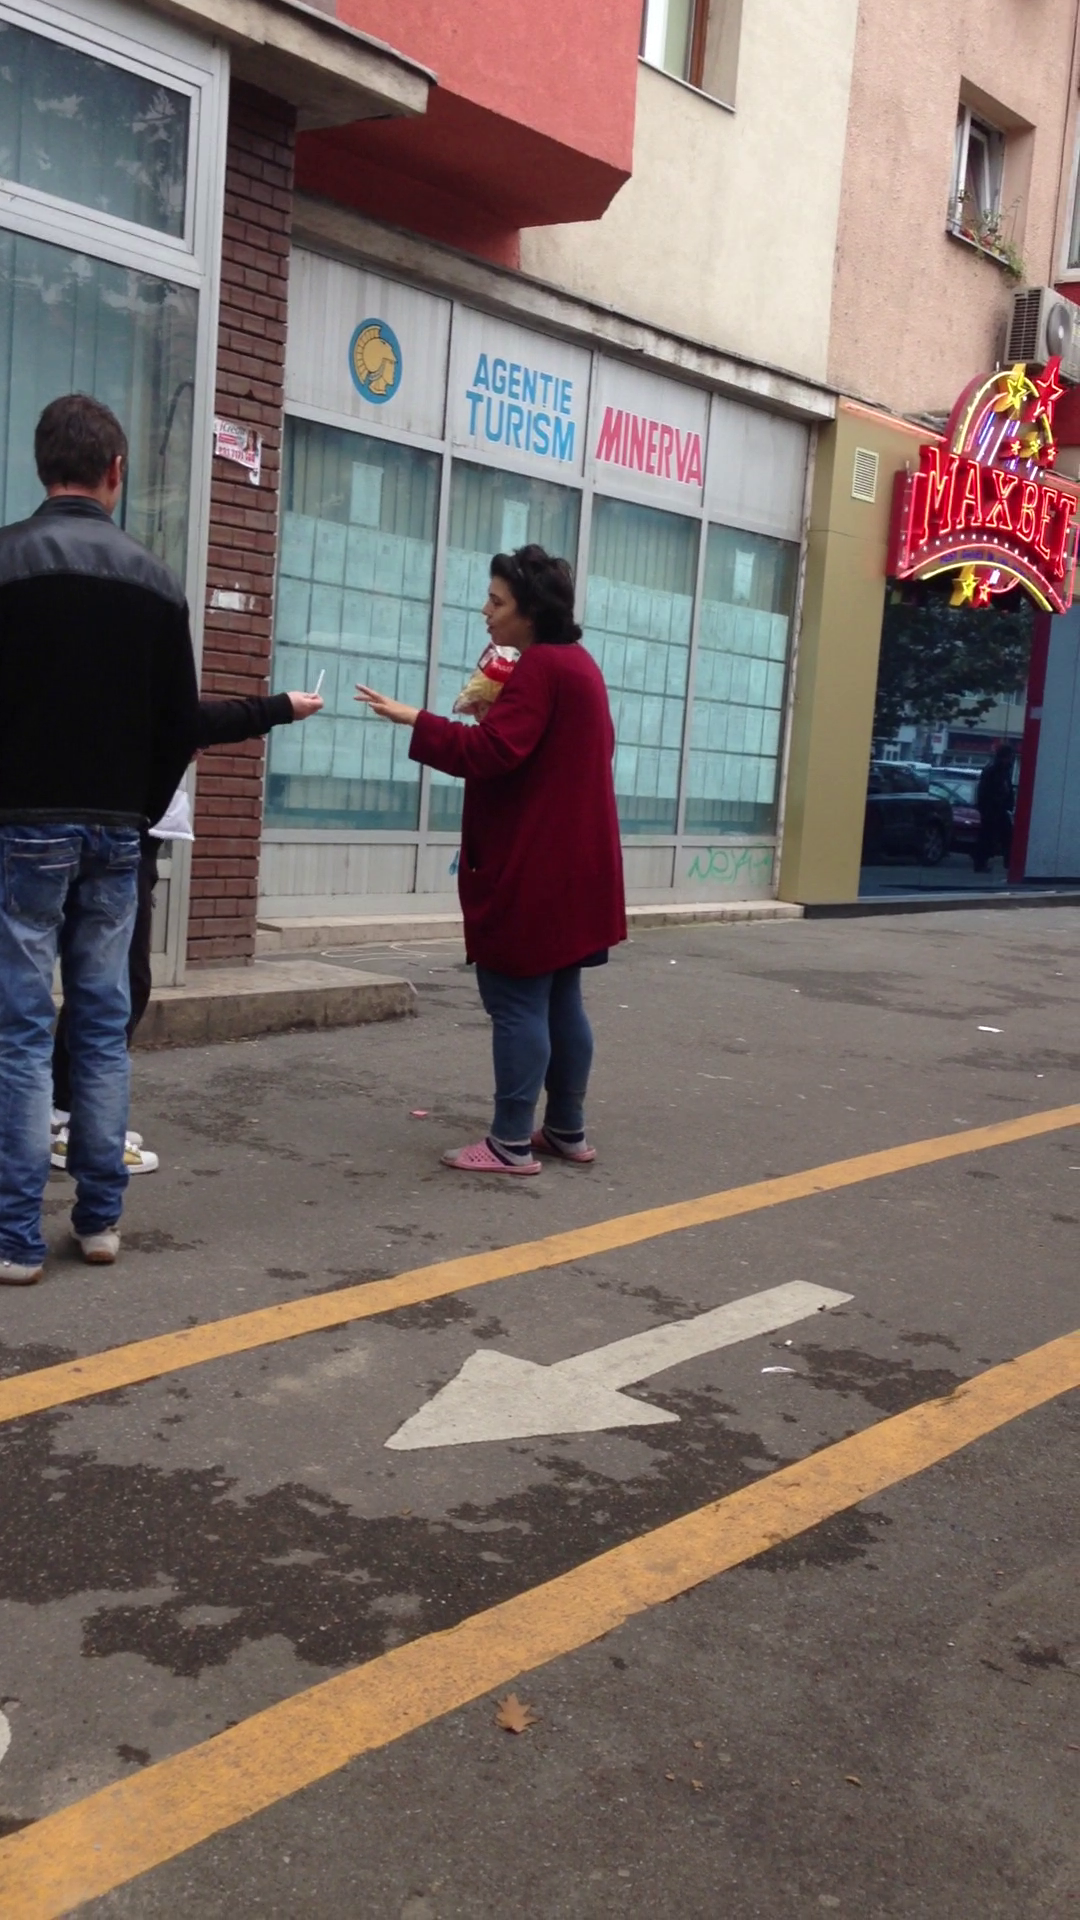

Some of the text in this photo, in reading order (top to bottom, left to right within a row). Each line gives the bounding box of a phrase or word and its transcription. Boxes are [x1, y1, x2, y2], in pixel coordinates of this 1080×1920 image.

[466, 390, 575, 461] TURISM
[595, 405, 702, 487] MINERVA
[919, 446, 1077, 578] MAXBET
